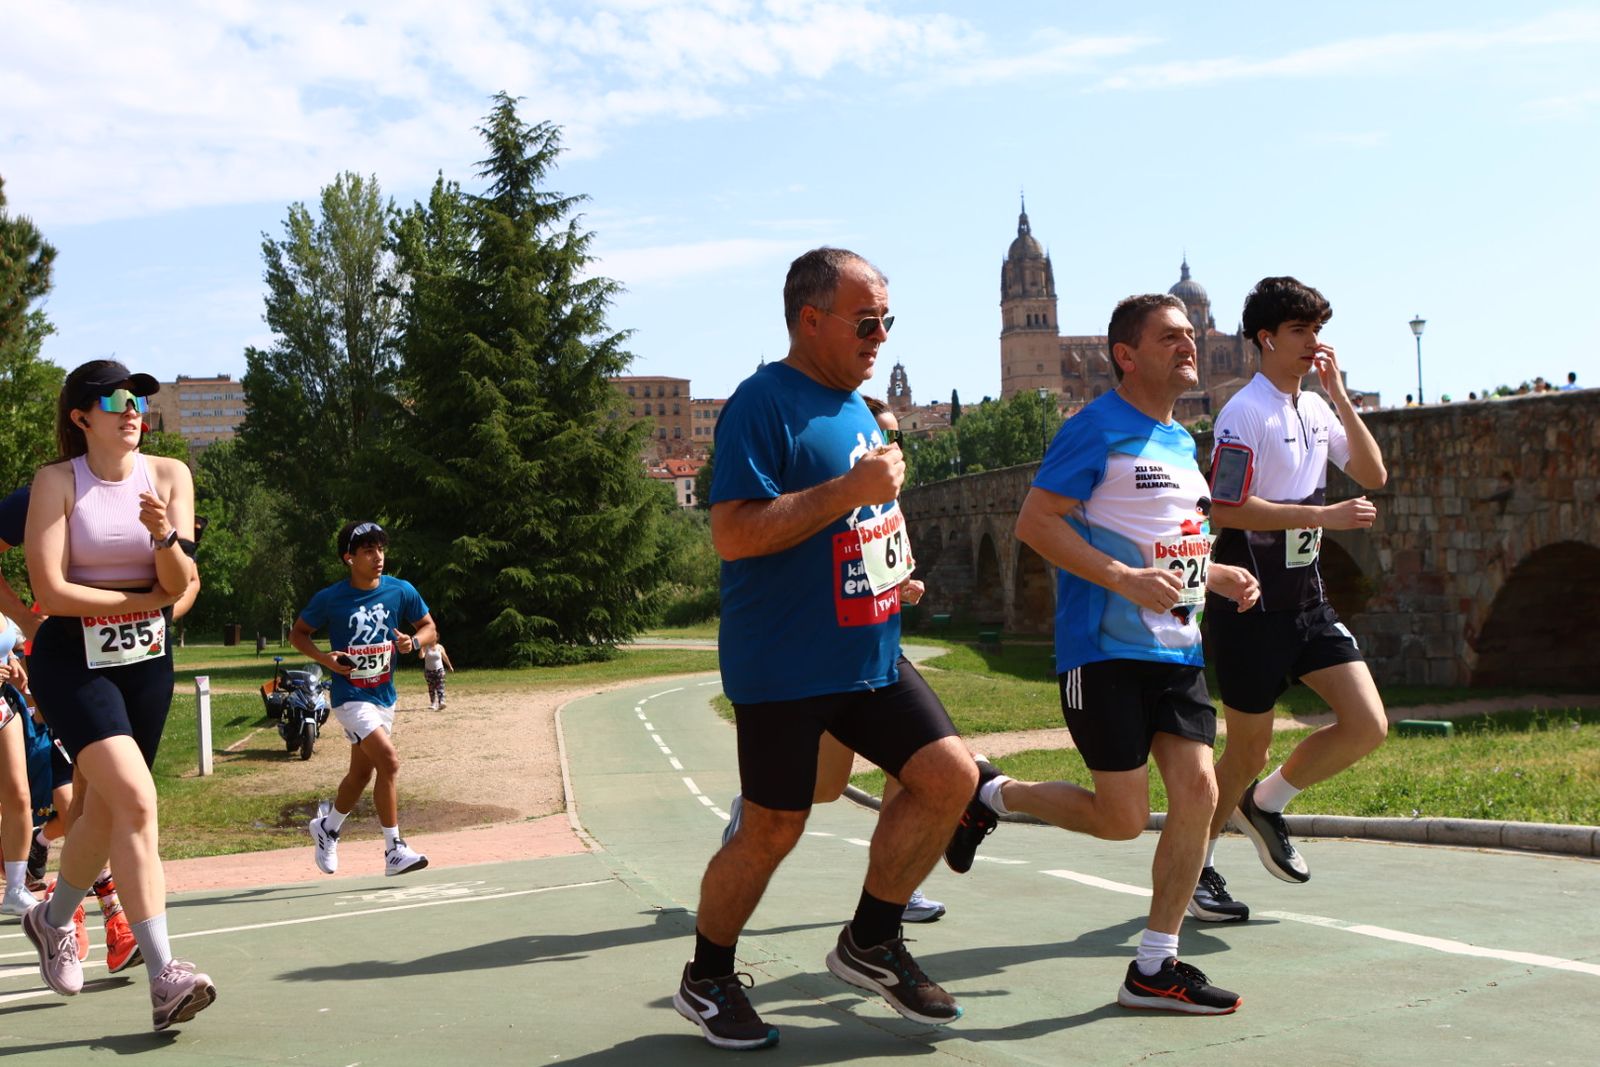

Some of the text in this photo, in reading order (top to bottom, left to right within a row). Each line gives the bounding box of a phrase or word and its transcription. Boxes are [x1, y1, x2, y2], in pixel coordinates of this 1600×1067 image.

[844, 579, 870, 595] en
[100, 621, 153, 652] 255
[357, 653, 385, 670] 251
